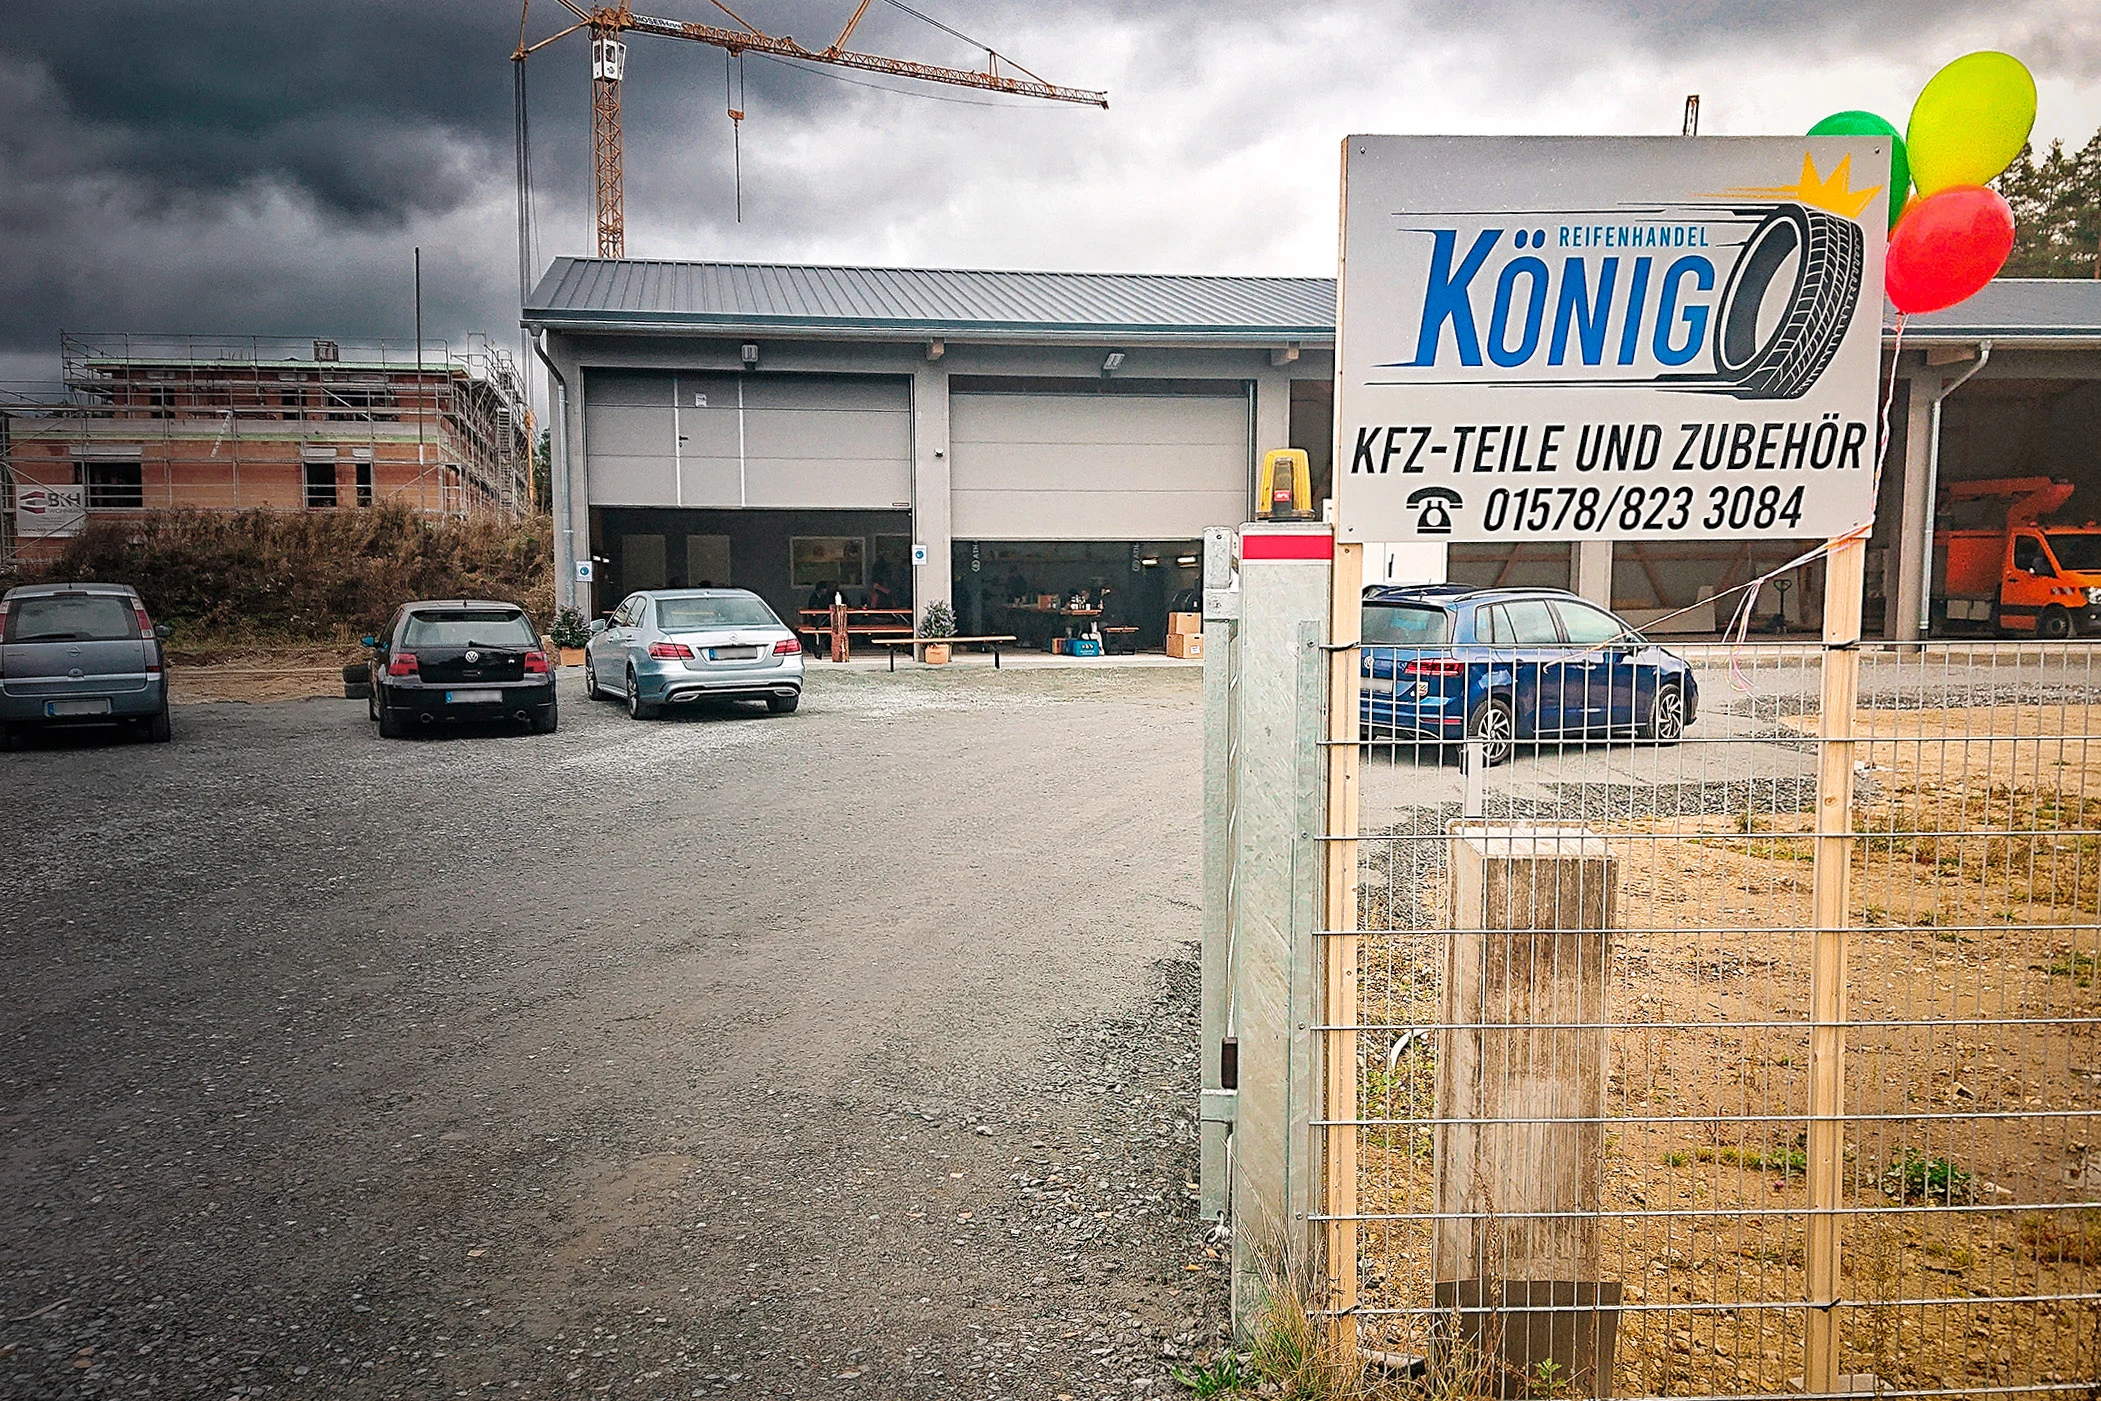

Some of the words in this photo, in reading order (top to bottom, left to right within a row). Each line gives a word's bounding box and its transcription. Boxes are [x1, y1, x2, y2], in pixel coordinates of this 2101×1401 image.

[1559, 226, 1709, 248] REIFENHANDEL
[1392, 228, 1716, 368] KÖNIG
[1350, 424, 1566, 474] KFZ-TEILE
[1575, 424, 1663, 472] UND
[1672, 412, 1867, 472] ZUBEHÖR
[1483, 485, 1694, 533] 01578/823
[1703, 485, 1805, 531] 3084
